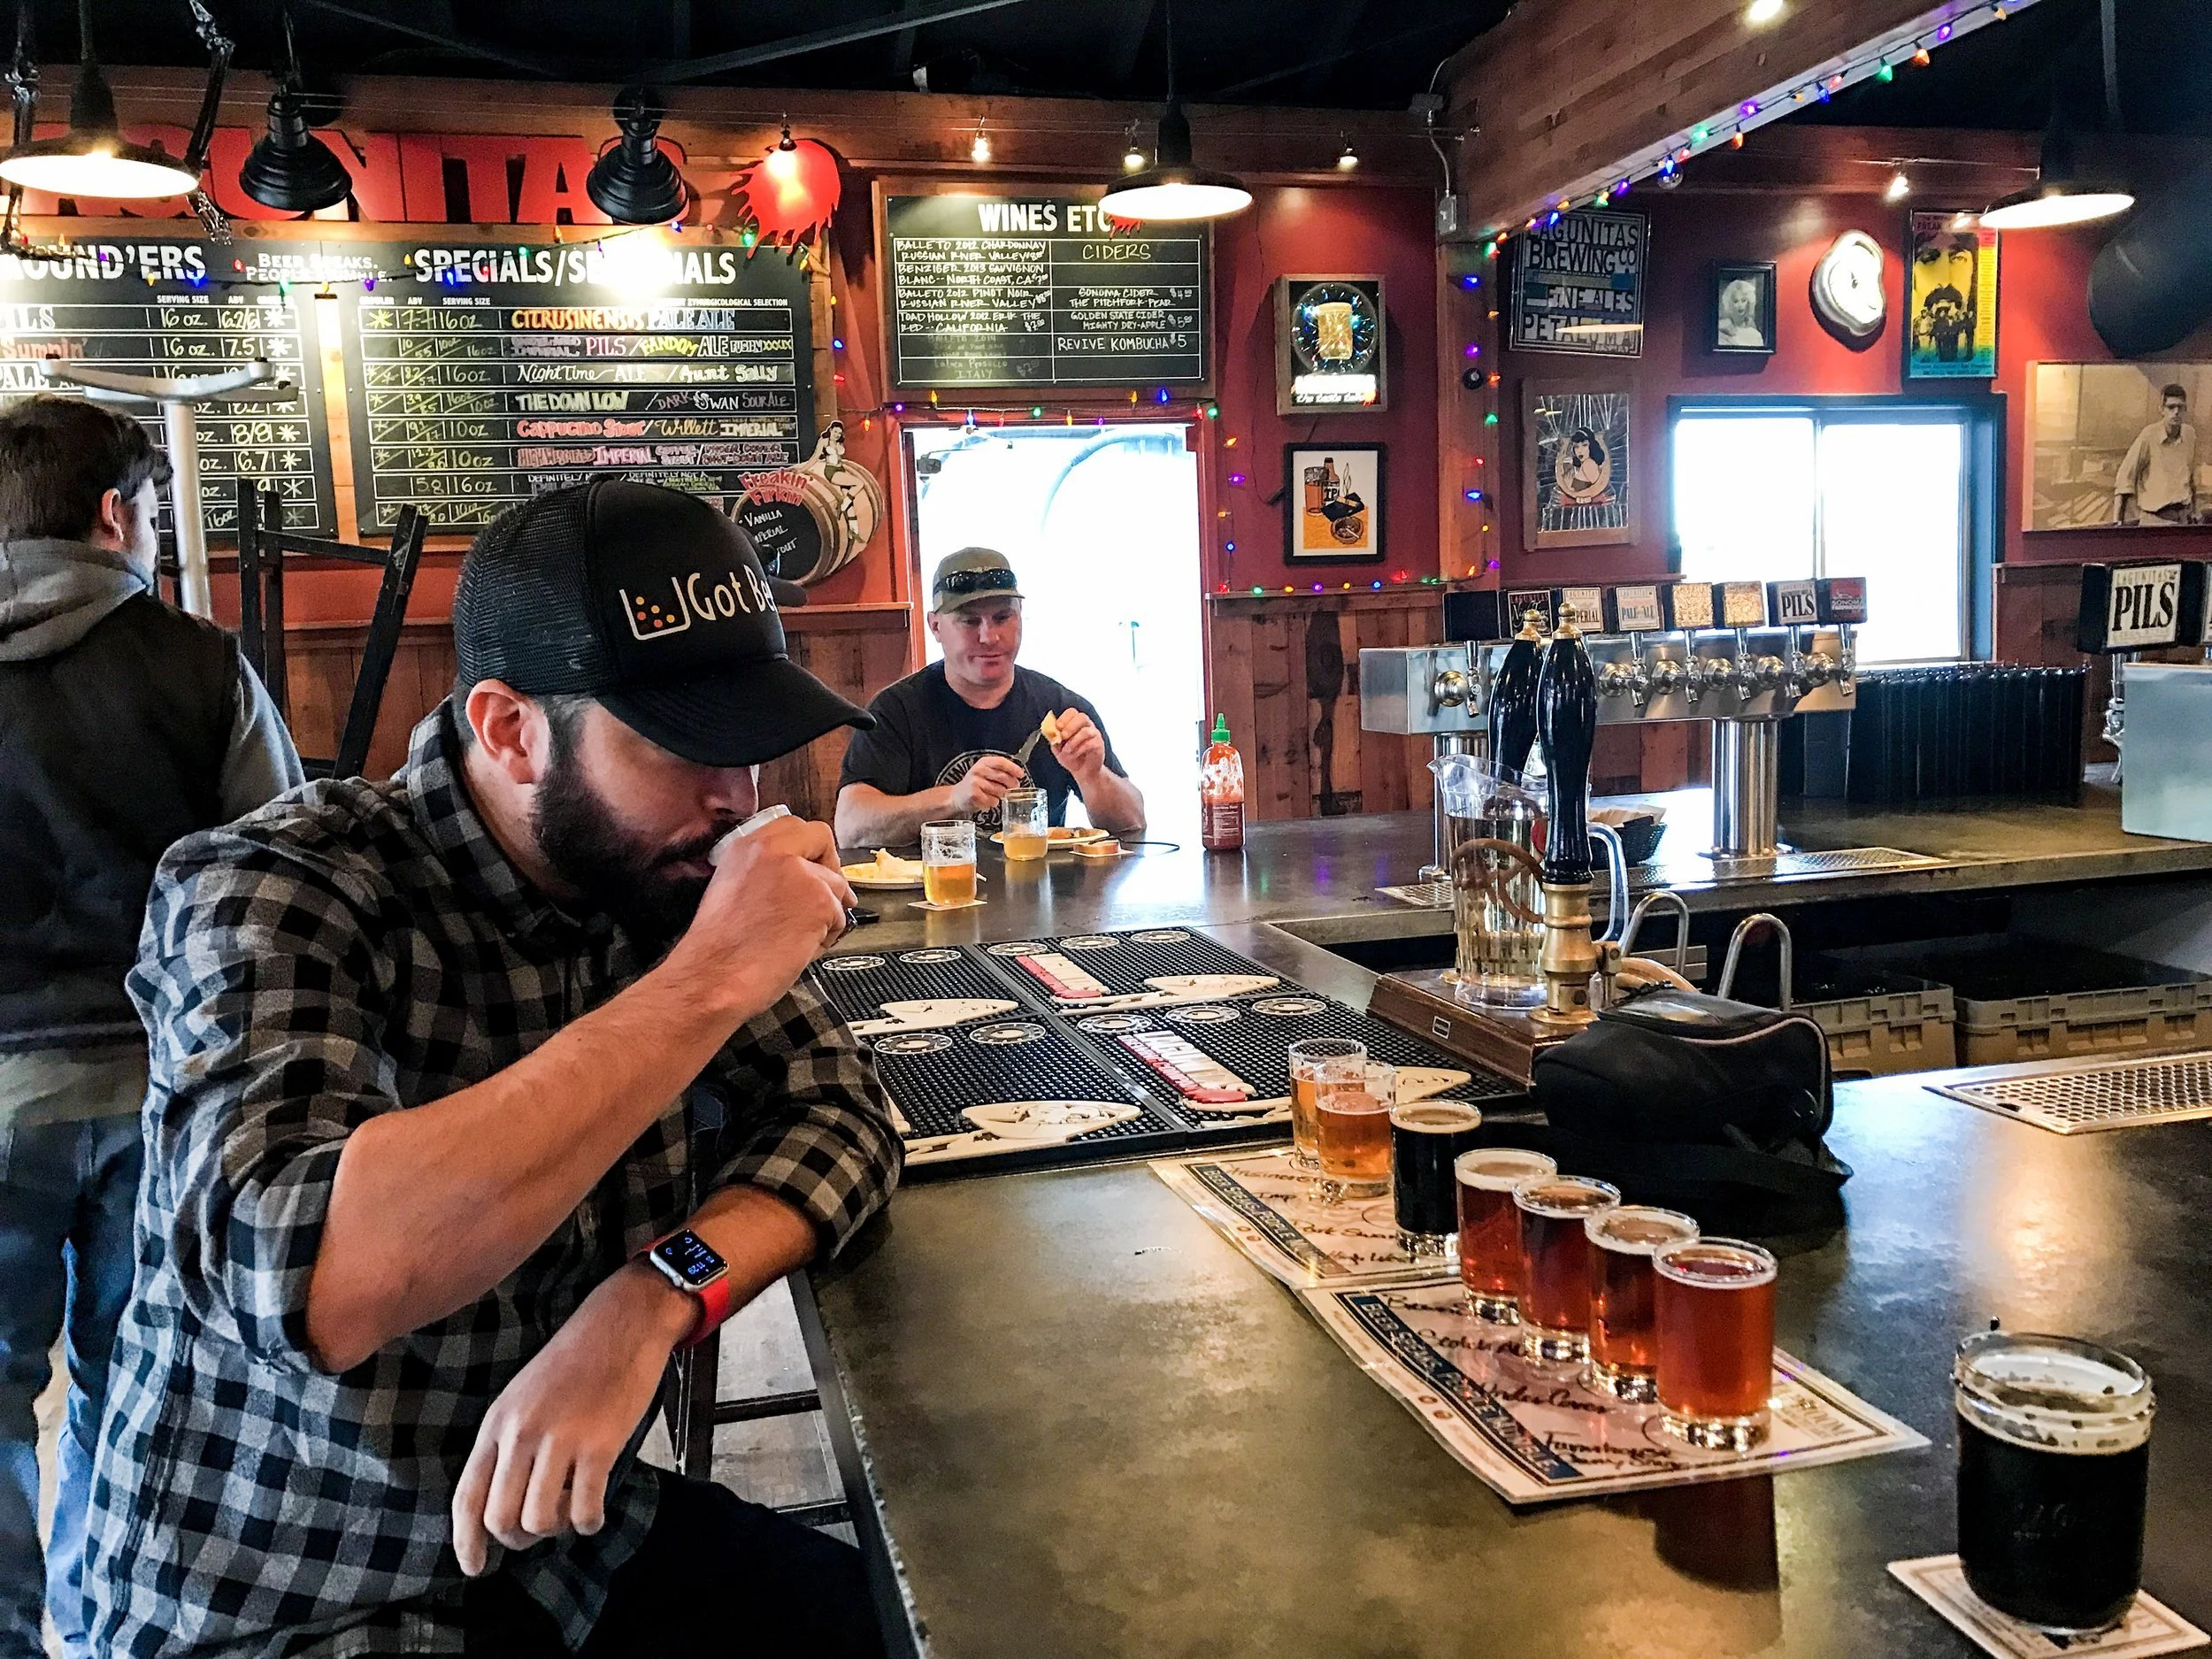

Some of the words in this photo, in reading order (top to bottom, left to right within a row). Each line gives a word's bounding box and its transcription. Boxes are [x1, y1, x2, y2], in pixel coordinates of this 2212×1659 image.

[978, 204, 1056, 232] WINES
[1528, 219, 1638, 247] AGUNITAS
[981, 241, 1046, 252] CHARDONNAY
[1082, 243, 1151, 260] CIDERS
[902, 251, 946, 261] RUSSIAN
[950, 251, 986, 261] RIVER
[989, 252, 1026, 262] VALLEY
[1528, 240, 1616, 274] BREWING
[898, 264, 962, 274] BENZIGER
[964, 264, 986, 273] 2013
[988, 264, 1044, 273] SAUVIGNON
[947, 275, 981, 285] NORTH
[157, 296, 189, 304] SERVING
[192, 296, 209, 304] SIZE
[407, 296, 423, 305] ABV
[898, 288, 943, 298] BALLETO
[946, 288, 969, 297] 2012
[972, 288, 1003, 297] PINOT
[1007, 289, 1033, 298] NOIR
[1078, 288, 1121, 297] SONOMA
[1122, 288, 1159, 298] CIDER
[901, 298, 947, 309] RUSSIAN
[950, 299, 990, 309] RIVER
[991, 299, 1036, 309] VALLEY
[1069, 298, 1089, 308] THE
[646, 309, 695, 330] PALE
[695, 309, 735, 330] ALE
[900, 311, 926, 322] TOAD
[927, 311, 969, 322] HOLLOW
[969, 311, 991, 320] 2012
[992, 311, 1018, 320] ERIK
[1020, 311, 1042, 320] THE
[1070, 311, 1108, 320] GOLDEN
[1110, 311, 1135, 319] STATE
[1136, 311, 1165, 319] CIDER
[935, 322, 1009, 334] CALIFORNIA
[1082, 320, 1118, 330] MIGHTY
[225, 337, 256, 357] 7.5
[586, 336, 626, 357] PILS
[697, 335, 730, 357] ALE
[1057, 337, 1105, 352] REVIVE
[1110, 337, 1170, 352] KOMBUCHA
[613, 364, 648, 382] ALE
[734, 364, 779, 382] Sally
[591, 390, 629, 411] LOW
[719, 422, 784, 437] IMPERIAL
[237, 450, 269, 472] 6.7
[749, 484, 805, 507] Firkin
[744, 510, 783, 526] VANILLA
[687, 572, 751, 621] Got
[1781, 594, 1815, 618] PILS
[2111, 581, 2175, 632] PILS
